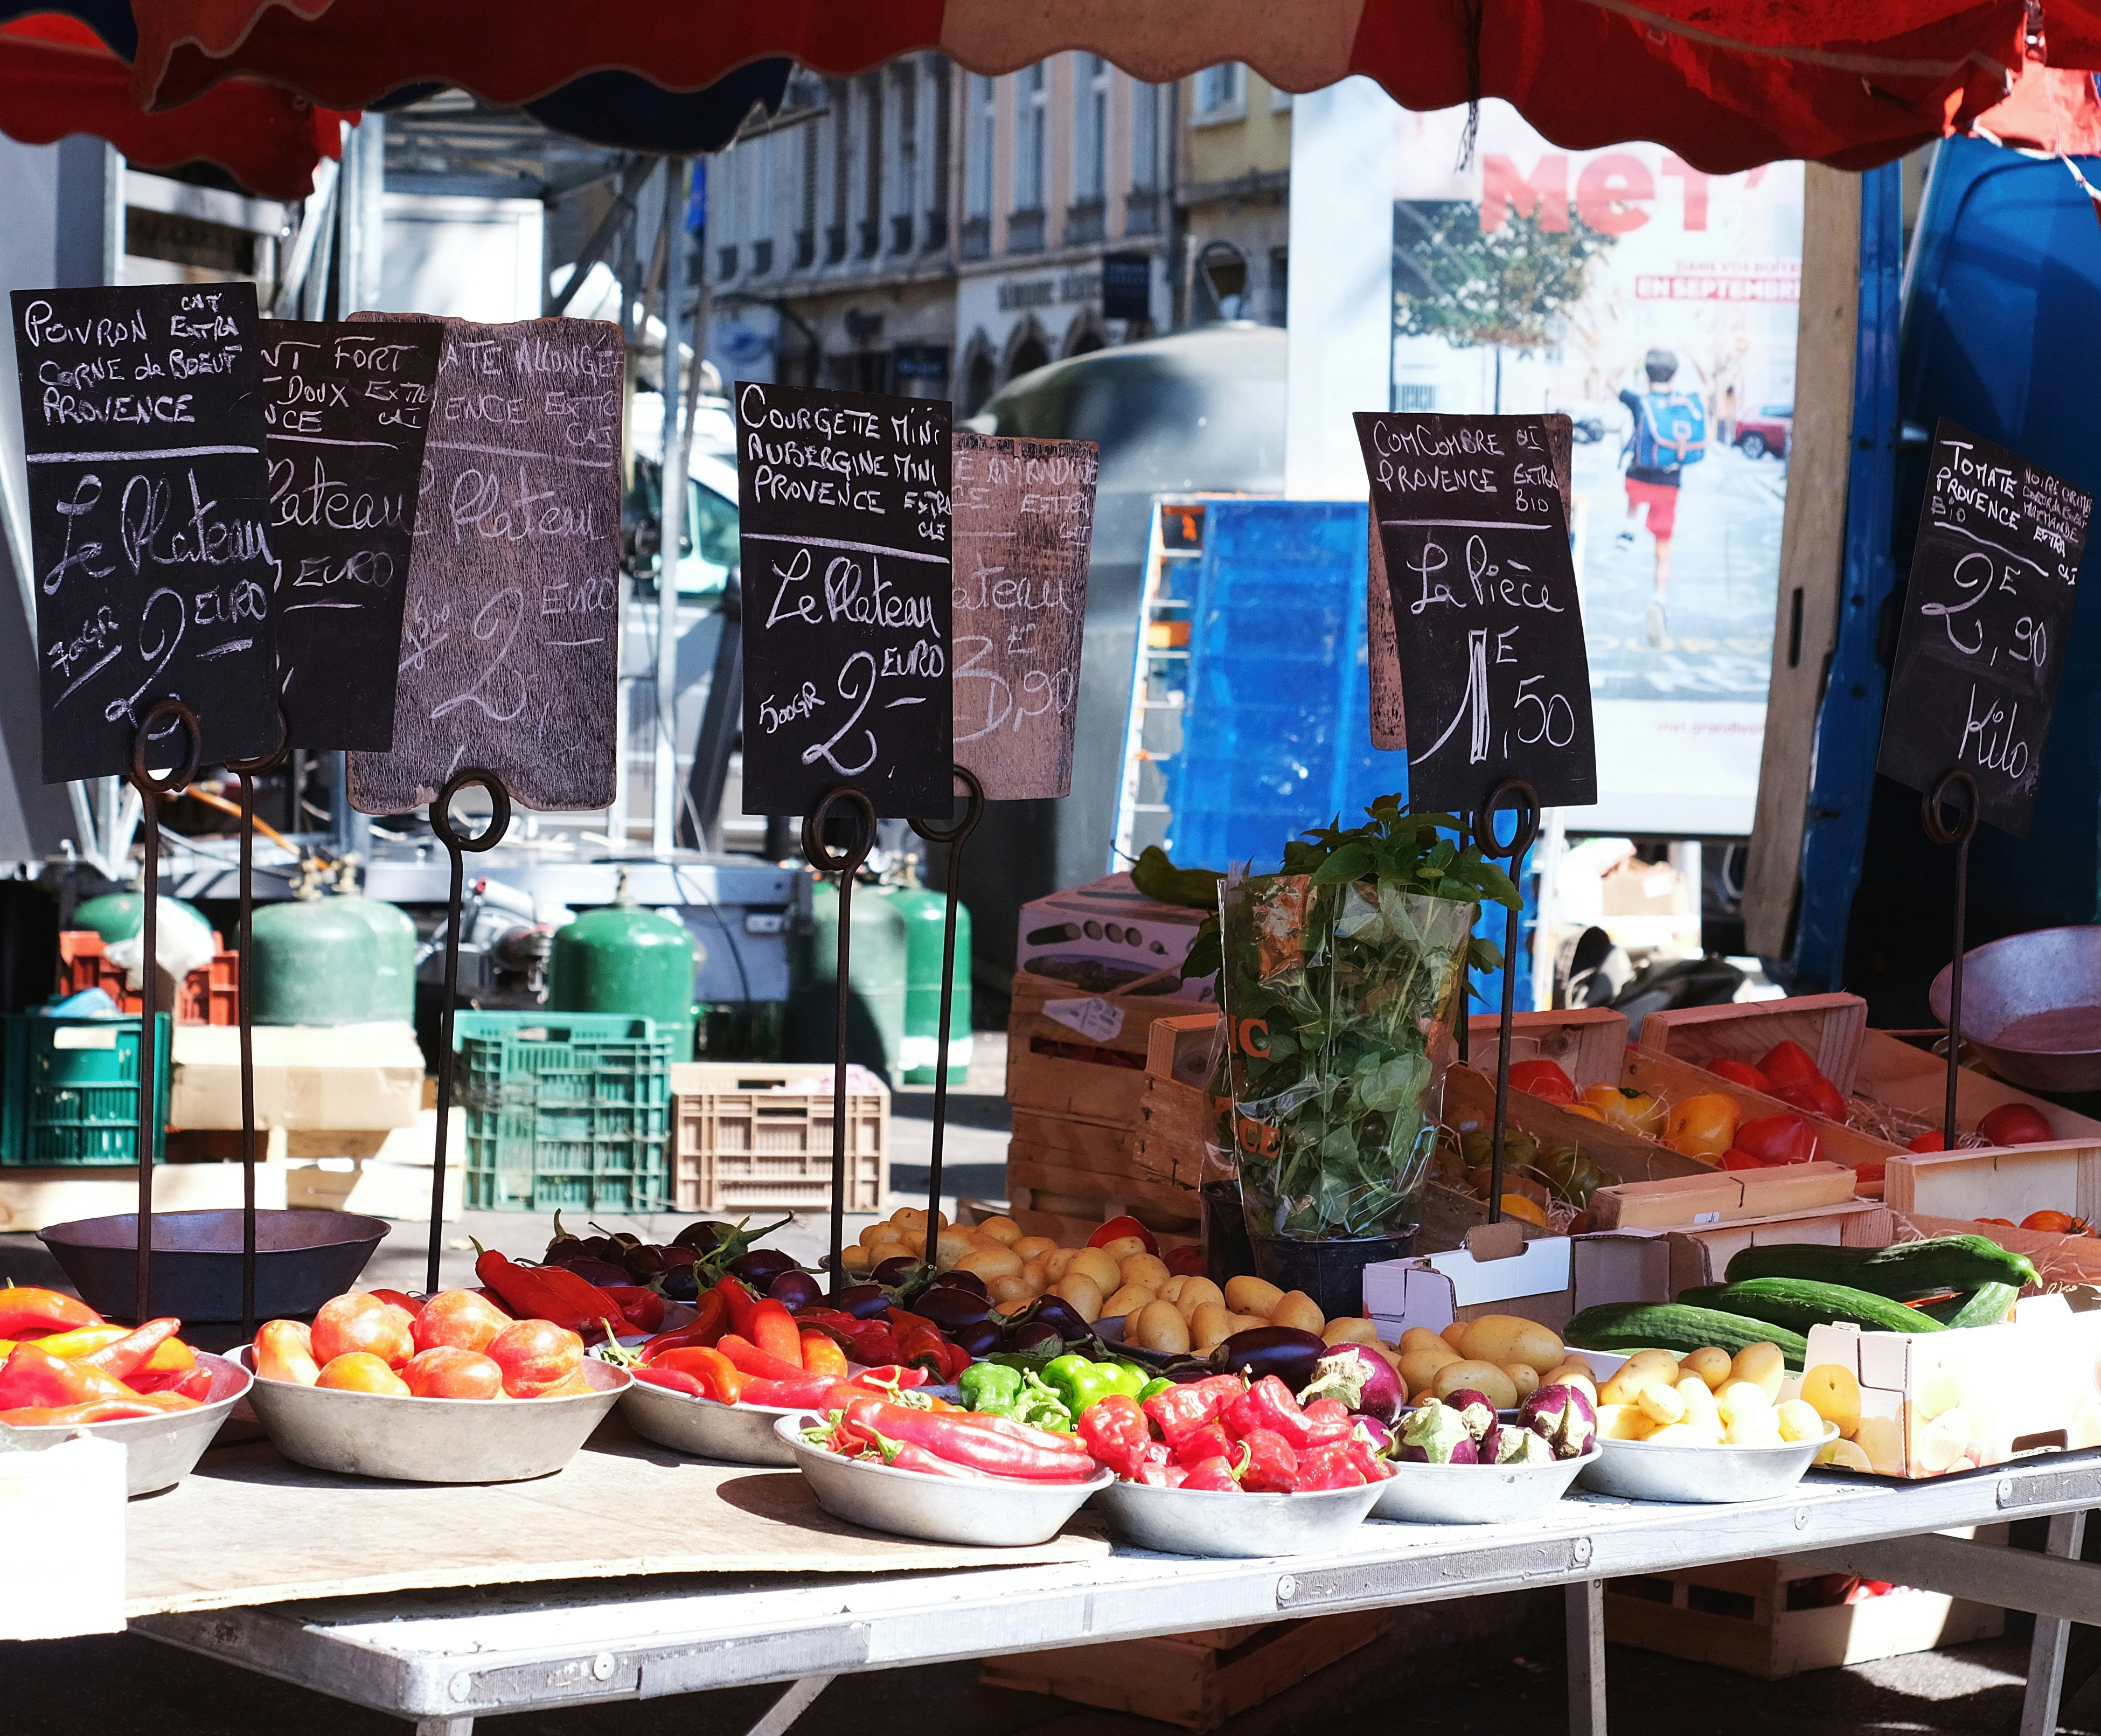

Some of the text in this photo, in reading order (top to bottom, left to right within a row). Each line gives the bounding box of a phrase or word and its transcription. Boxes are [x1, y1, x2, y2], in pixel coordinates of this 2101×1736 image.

[42, 386, 196, 426] PROVENCE
[277, 375, 350, 407] DOUX
[741, 384, 880, 441] COURGETTE
[748, 433, 937, 486] AUBERGINE MINI
[1376, 459, 1498, 492] PROVENCE
[1940, 439, 2017, 499] TOMATE
[755, 464, 885, 514] PROVENCE
[1516, 488, 1549, 512] BIO
[1936, 466, 2020, 530] PROVENCE
[293, 550, 394, 588] EURO
[766, 548, 823, 629] Le
[194, 578, 268, 625] EURO
[801, 639, 945, 776] 2 EURO
[1958, 683, 2028, 779] Kilo
